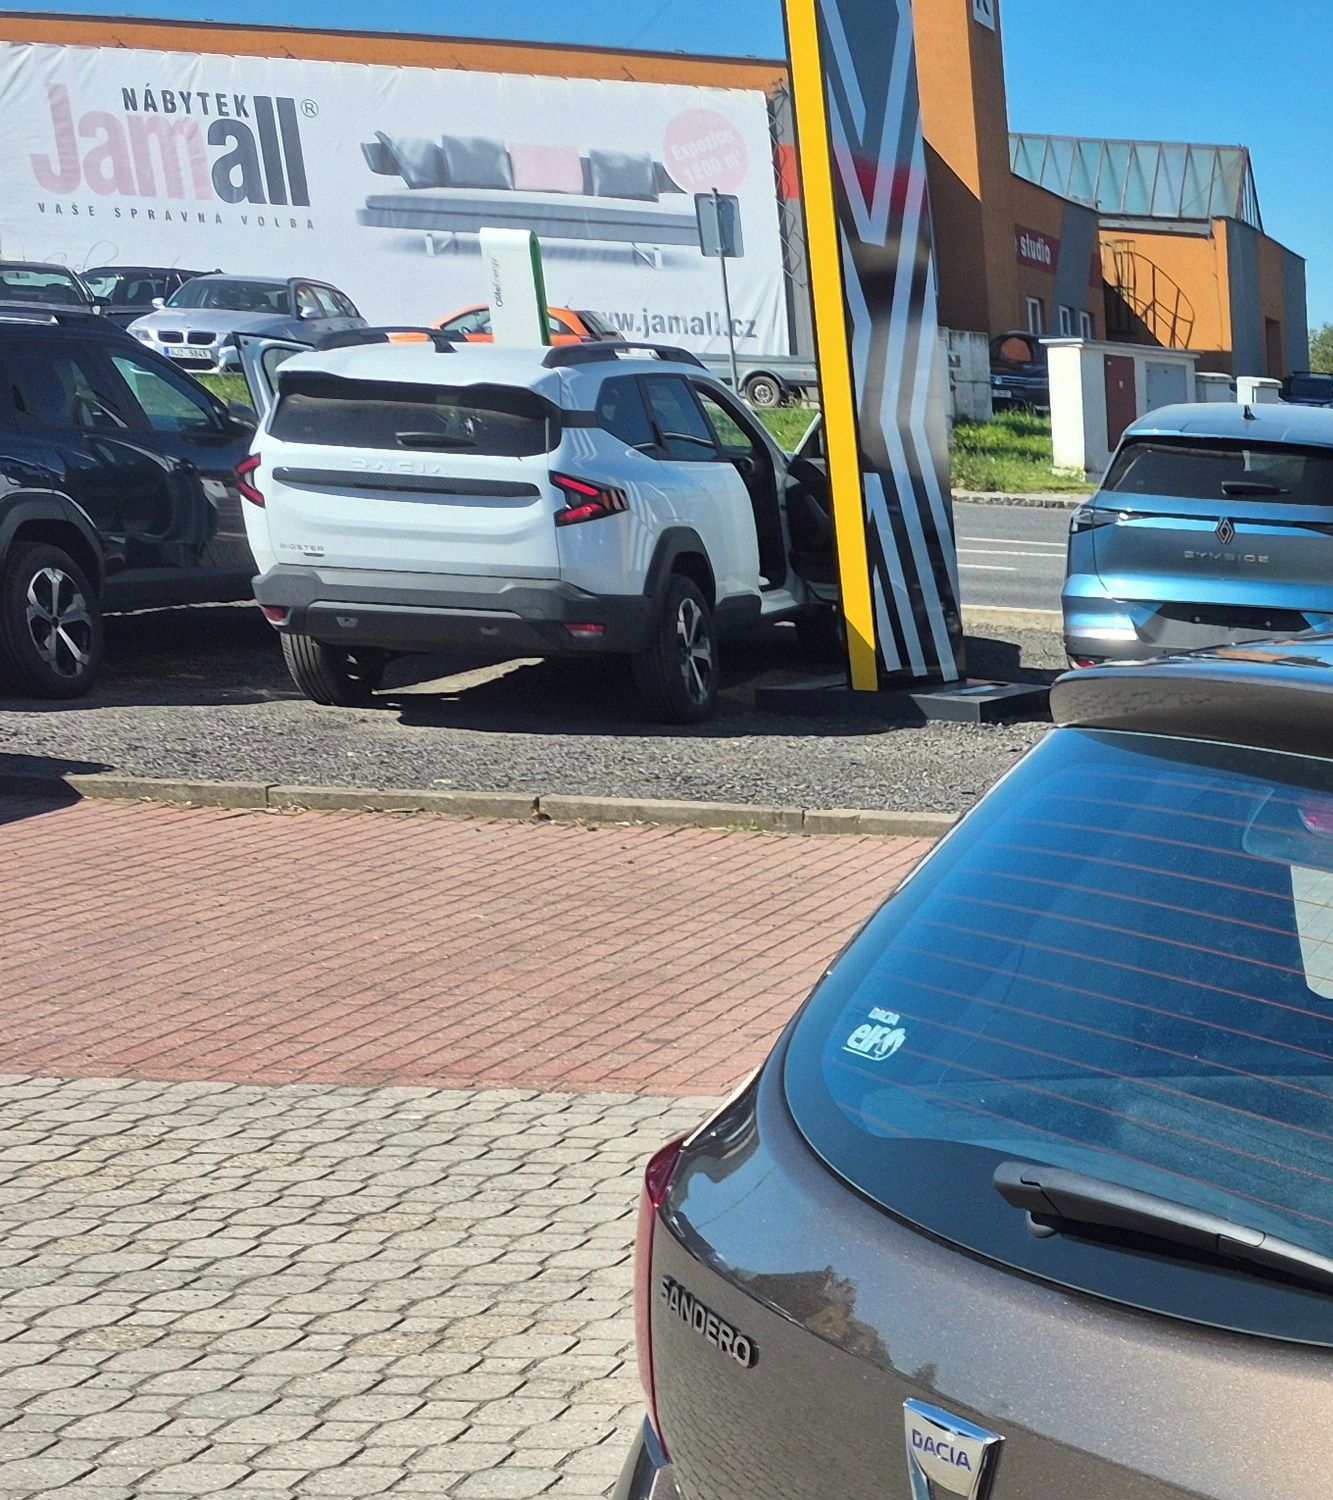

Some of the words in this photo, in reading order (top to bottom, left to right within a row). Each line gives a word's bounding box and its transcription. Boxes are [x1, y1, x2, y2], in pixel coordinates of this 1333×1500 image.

[121, 83, 250, 118] NÁBYTEK
[30, 83, 311, 207] Jamall
[240, 214, 315, 230] VOLBA
[1020, 232, 1051, 265] studio
[660, 1275, 757, 1368] SANDERO
[912, 1428, 972, 1472] DACIA
